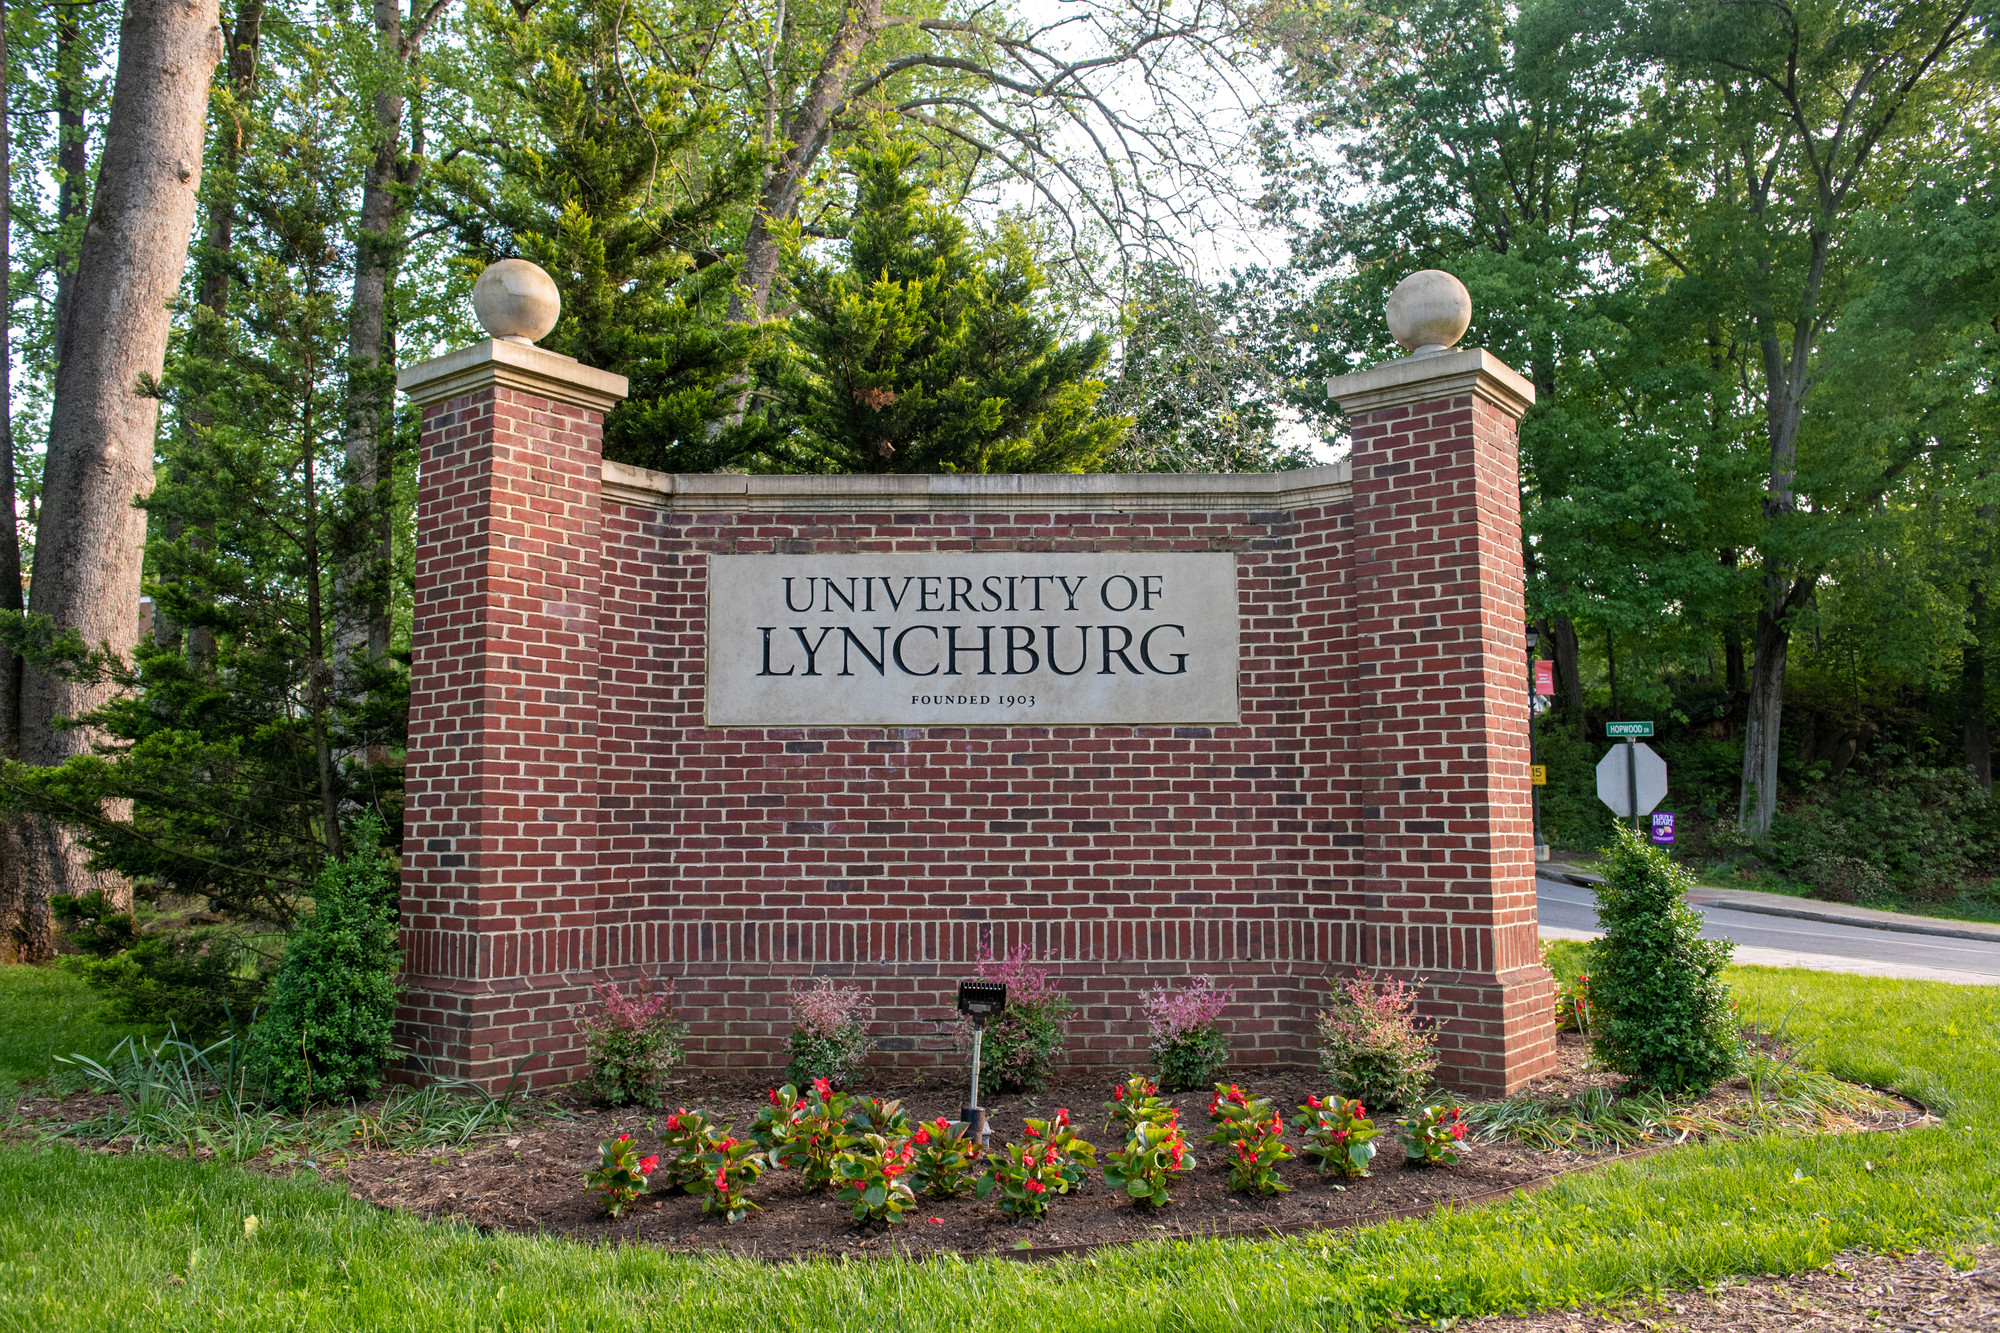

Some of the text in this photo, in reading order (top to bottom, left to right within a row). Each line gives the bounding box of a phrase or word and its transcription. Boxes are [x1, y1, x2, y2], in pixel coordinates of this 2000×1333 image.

[782, 574, 1163, 612] UNIVERSITY OF
[756, 624, 1189, 676] LYNCHBURG
[911, 695, 1036, 708] FOUNDED 1903
[1610, 725, 1643, 733] HOPWOOD
[1531, 767, 1542, 777] 15
